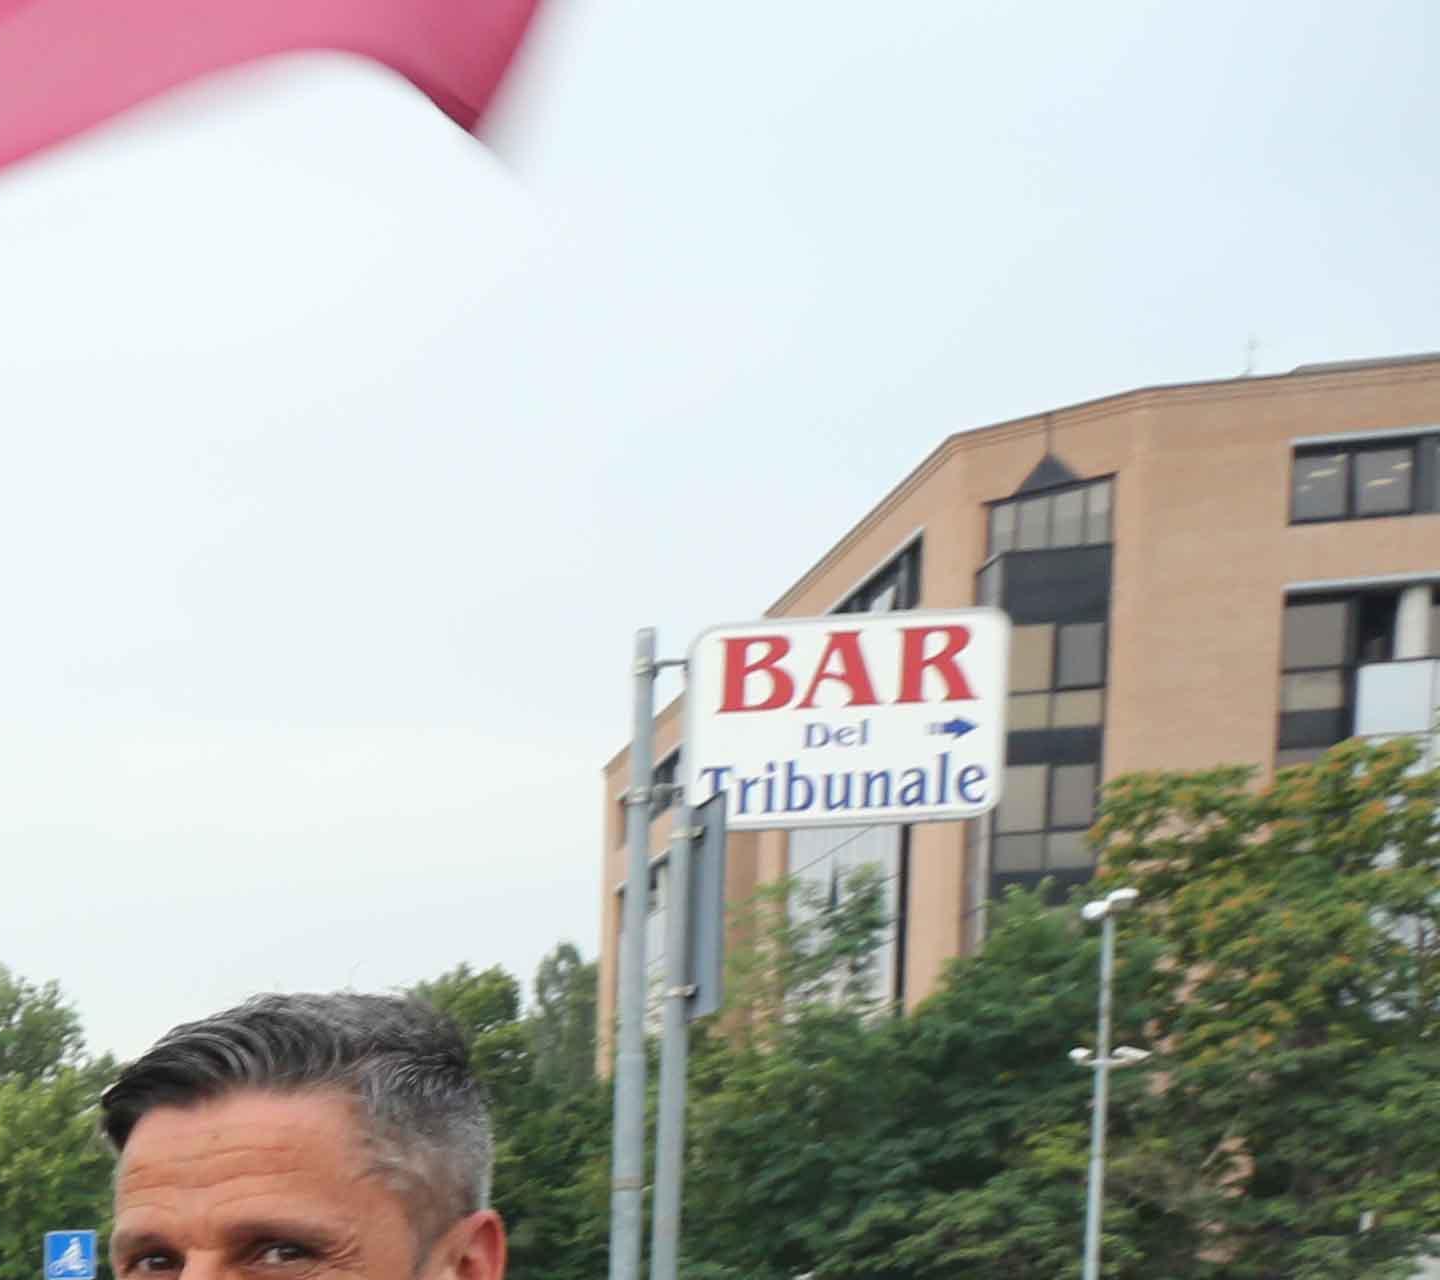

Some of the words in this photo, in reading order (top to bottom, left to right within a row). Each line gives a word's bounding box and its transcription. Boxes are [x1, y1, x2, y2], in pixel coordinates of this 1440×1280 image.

[715, 625, 979, 713] BAR
[803, 719, 871, 748] Del
[698, 751, 988, 815] Tribunale
